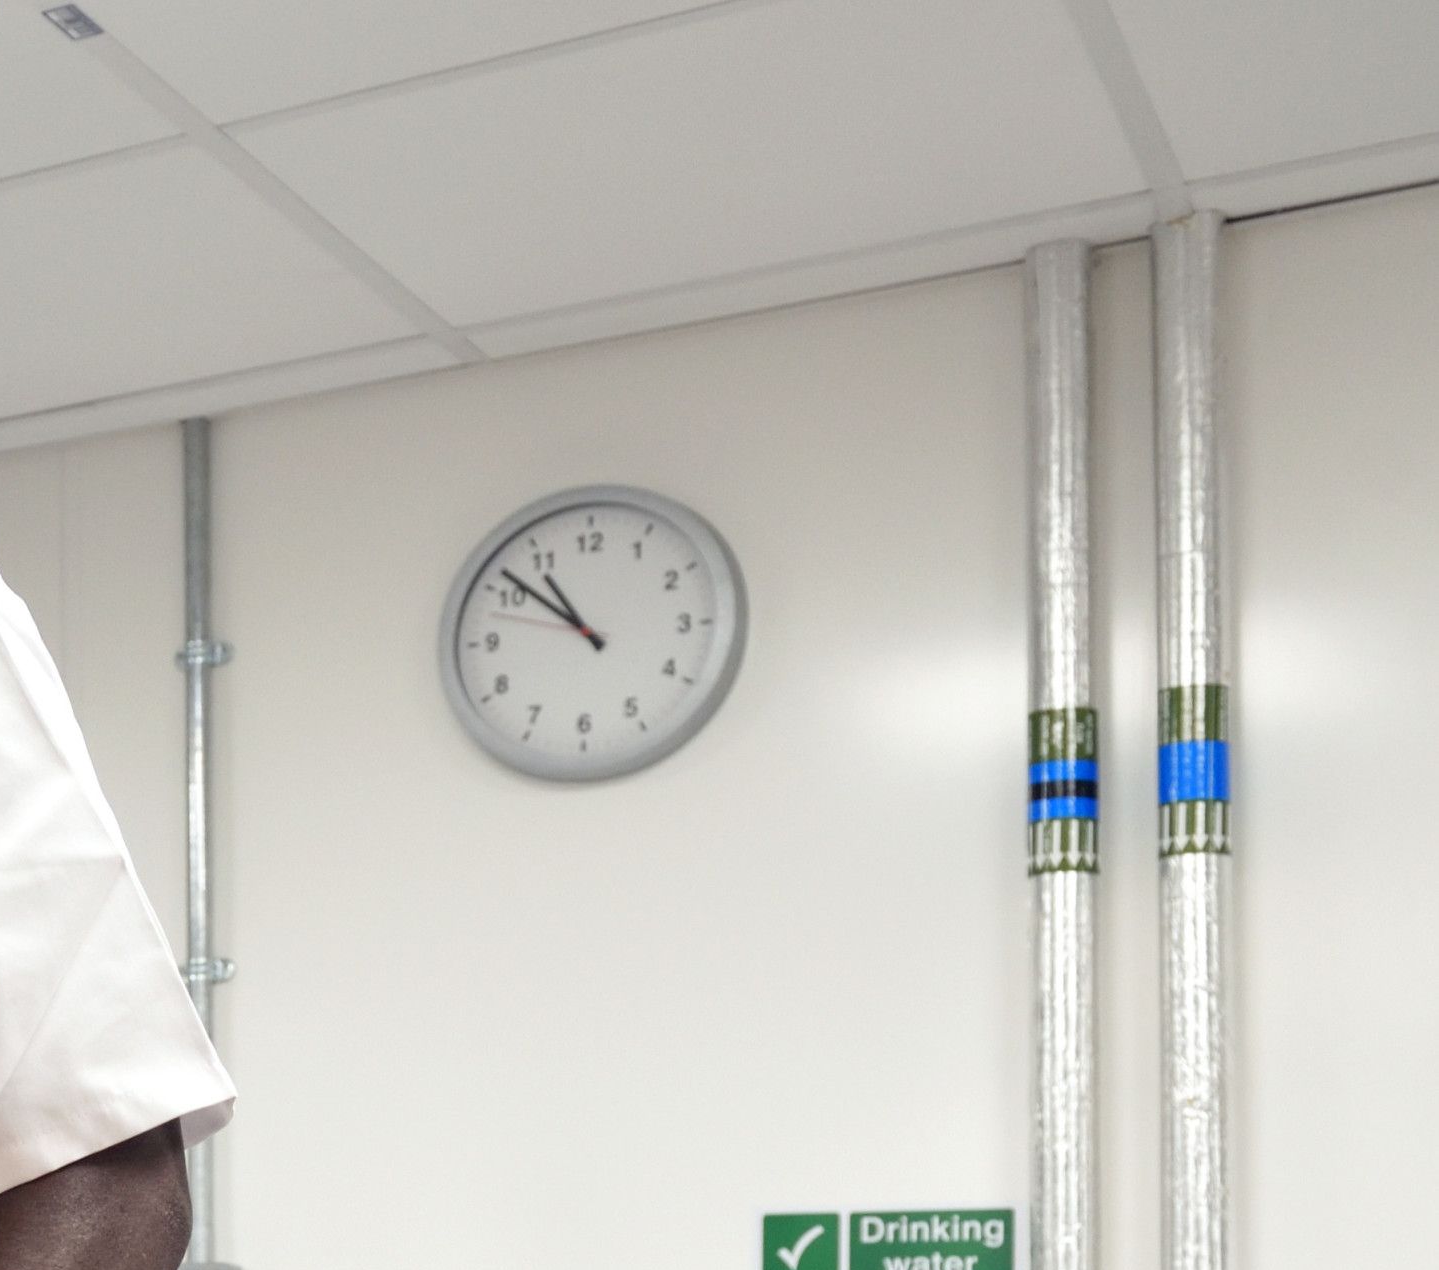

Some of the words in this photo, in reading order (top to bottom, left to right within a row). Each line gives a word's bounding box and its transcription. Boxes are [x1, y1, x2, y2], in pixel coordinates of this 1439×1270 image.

[576, 532, 605, 554] 12
[632, 541, 643, 560] 1
[533, 551, 555, 571] 11
[664, 570, 680, 591] 2
[499, 586, 526, 608] 10
[676, 613, 692, 634] 3
[485, 632, 501, 653] 9
[661, 658, 677, 677] 4
[493, 674, 510, 695] 8
[527, 704, 543, 726] 7
[624, 697, 639, 718] 5
[576, 713, 593, 735] 6
[859, 1214, 1005, 1249] Drinking
